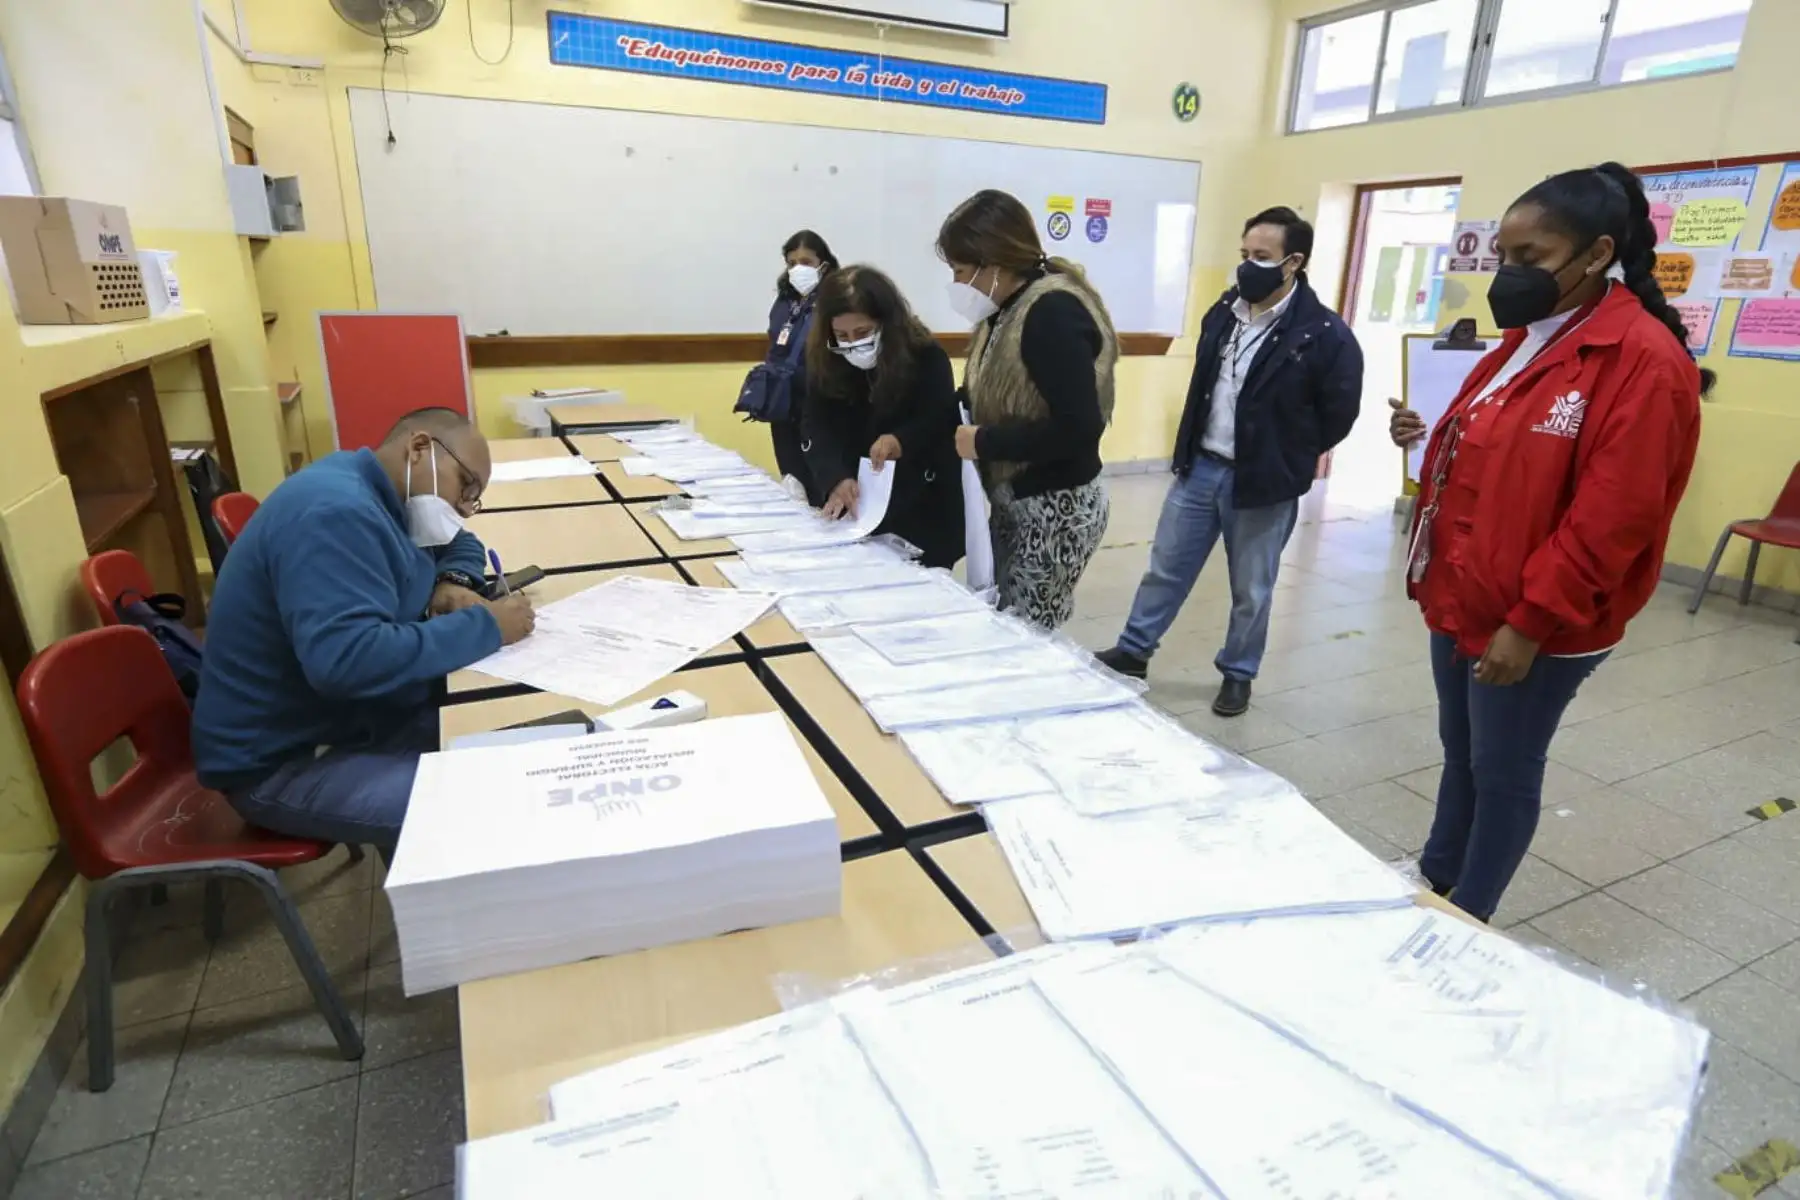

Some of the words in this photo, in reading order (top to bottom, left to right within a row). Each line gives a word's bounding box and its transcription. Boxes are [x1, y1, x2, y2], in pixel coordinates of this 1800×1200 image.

[790, 62, 838, 82] para
[847, 66, 866, 83] la
[872, 70, 913, 89] vida
[918, 78, 932, 95] y
[938, 80, 956, 94] el
[962, 83, 1025, 105] trabajo
[1177, 94, 1197, 113] 14
[99, 233, 123, 253] ONPE
[1544, 414, 1583, 433] JNE
[525, 762, 593, 777] SUFRAGIO
[558, 765, 632, 781] ELECTORAL
[635, 760, 669, 770] ACTA
[547, 774, 682, 807] ONPE
